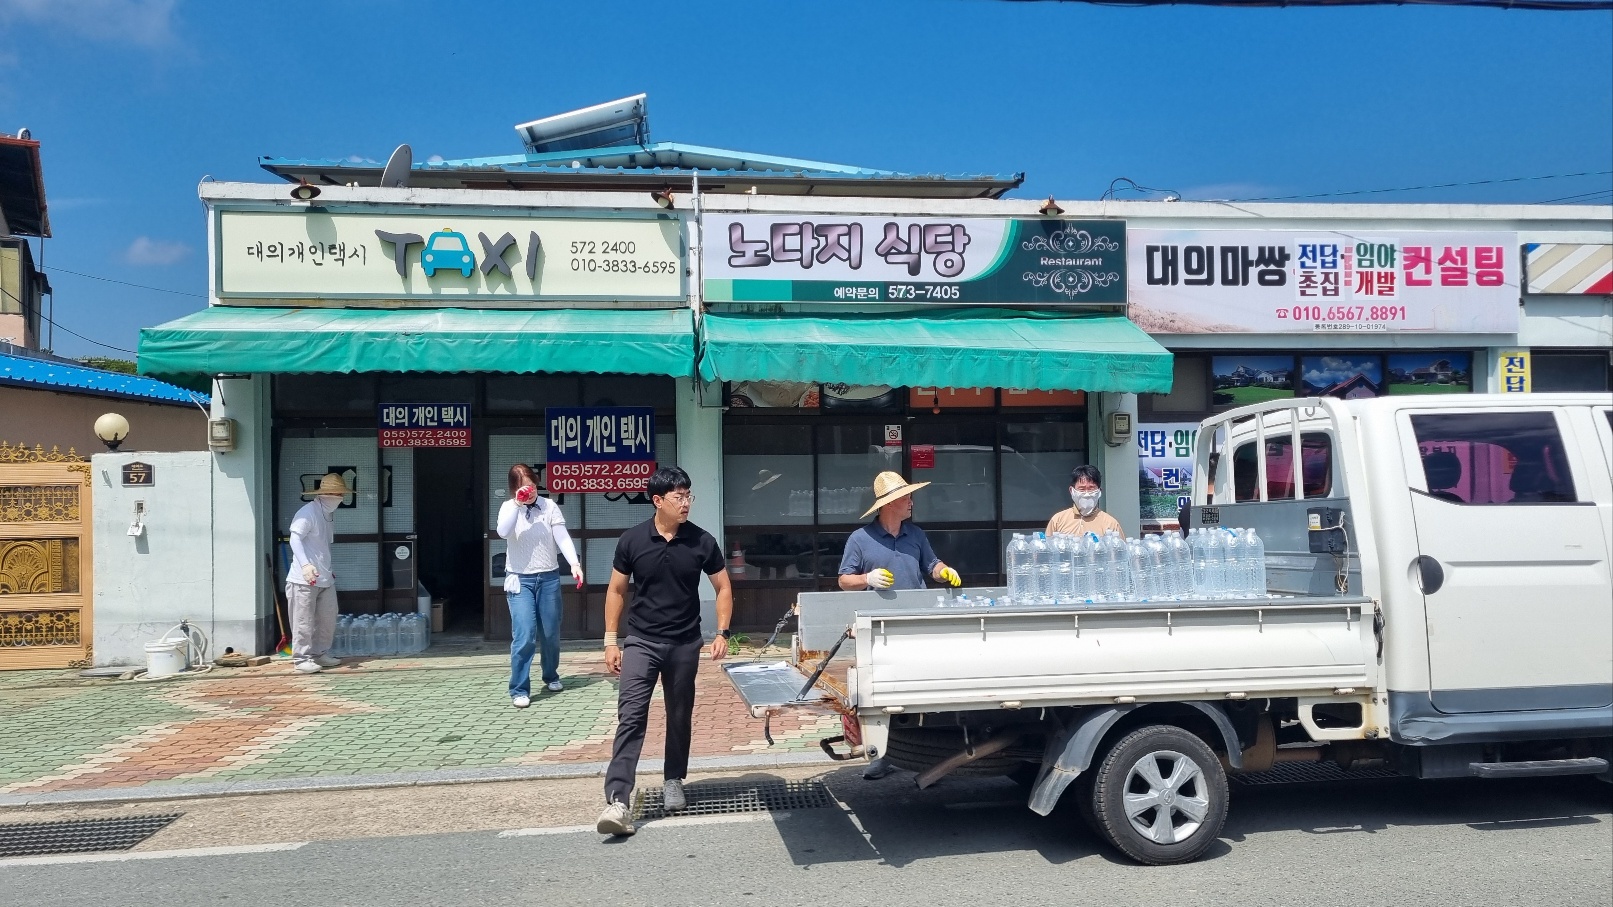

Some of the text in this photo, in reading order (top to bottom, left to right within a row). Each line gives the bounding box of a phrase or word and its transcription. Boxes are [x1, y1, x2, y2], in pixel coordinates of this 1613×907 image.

[247, 241, 366, 267] 대의개인택시
[570, 241, 636, 254] 572 2400
[728, 222, 971, 277] 노다지 식당
[1040, 257, 1102, 266] Restaurant
[1355, 243, 1397, 268] 임야
[571, 258, 676, 274] 010-3833-6595
[1145, 243, 1291, 287] 대의마쌍
[1402, 245, 1505, 288] 컨설팅
[1298, 271, 1396, 296] 촌집 개발
[834, 285, 960, 300] 예약문의 573-7405
[1293, 306, 1406, 321] 010.6567.8891
[383, 406, 466, 426] 대의 개인 택시
[383, 430, 466, 438] 055)572.2400
[551, 414, 650, 454] 대의 개인 택시
[383, 439, 466, 447] 010.3833.6595
[552, 464, 650, 476] 055)572.2400
[130, 473, 146, 483] 57
[552, 478, 649, 490] 010.3833.6595
